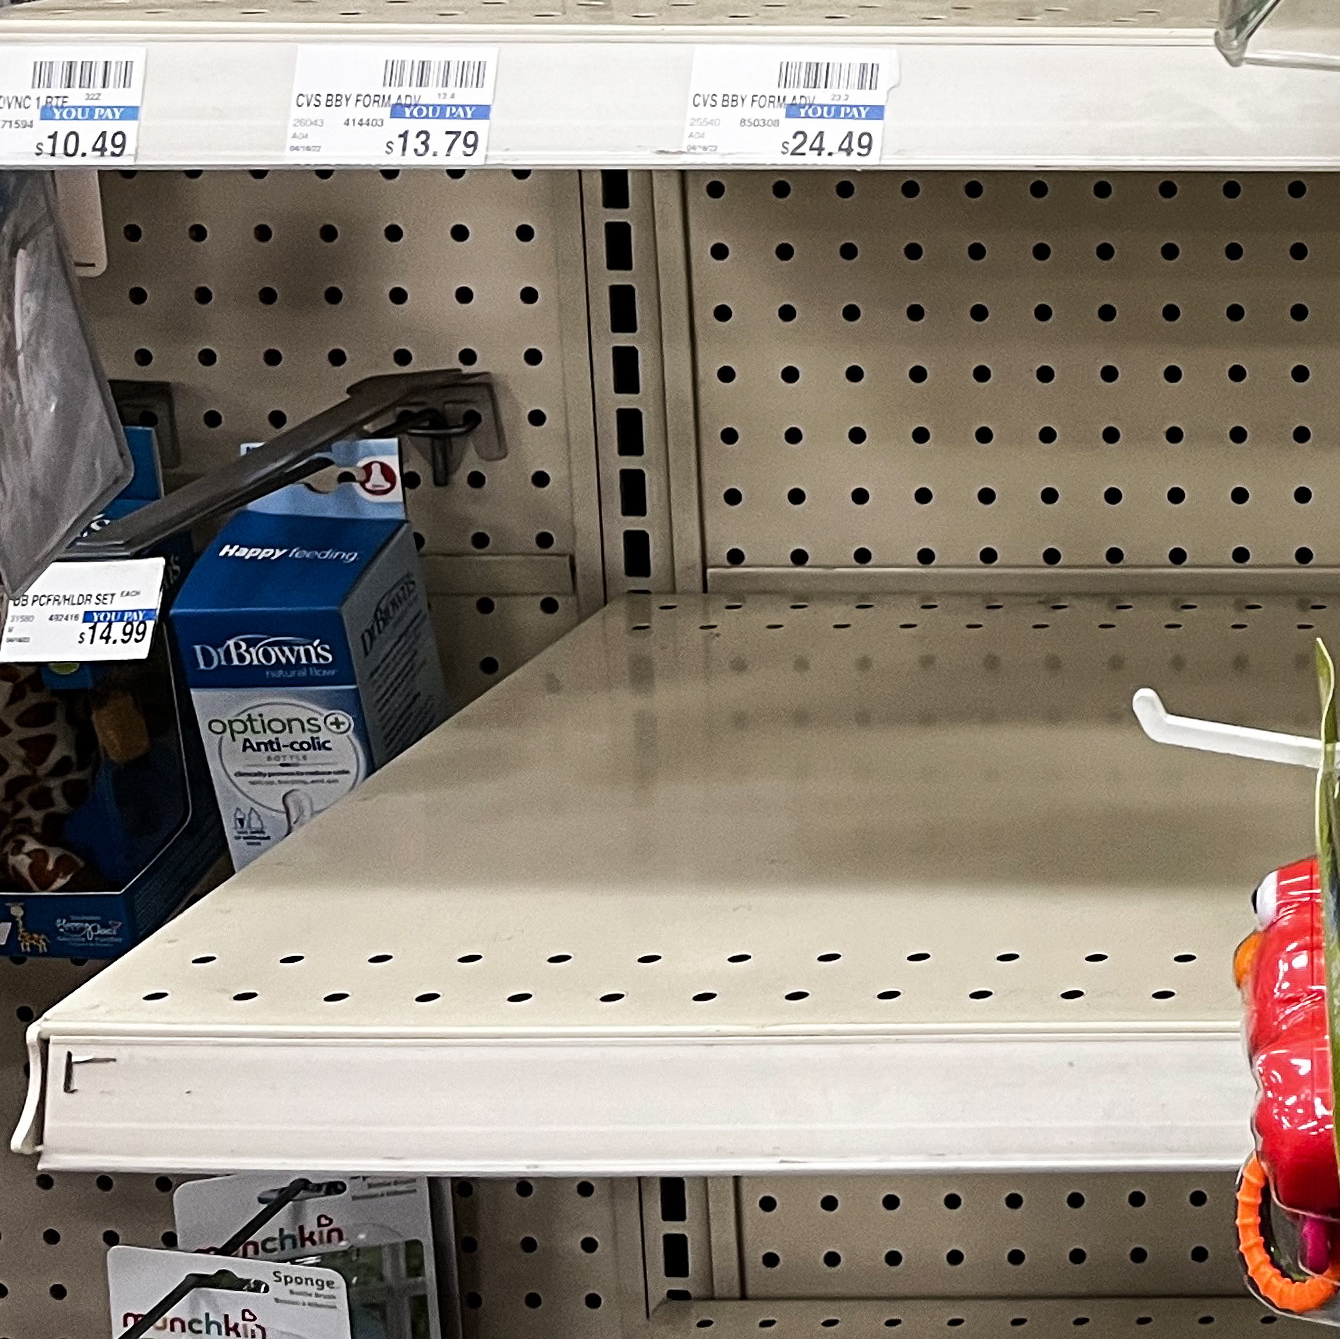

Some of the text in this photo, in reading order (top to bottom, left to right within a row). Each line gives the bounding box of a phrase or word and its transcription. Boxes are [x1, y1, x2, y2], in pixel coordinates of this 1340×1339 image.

[296, 94, 352, 108] CVS BBY
[692, 94, 748, 108] CVS BBY
[799, 106, 870, 119] YOU PAY
[35, 131, 127, 157] $10.49
[385, 129, 479, 157] $13.79
[781, 130, 874, 157] $24.49
[218, 544, 288, 560] Happy
[95, 593, 116, 605] SET
[92, 611, 146, 621] YOU PAY
[78, 621, 147, 644] $14.99
[208, 713, 322, 742] options
[242, 737, 333, 752] Anti-colic
[272, 1271, 335, 1290] Sponge
